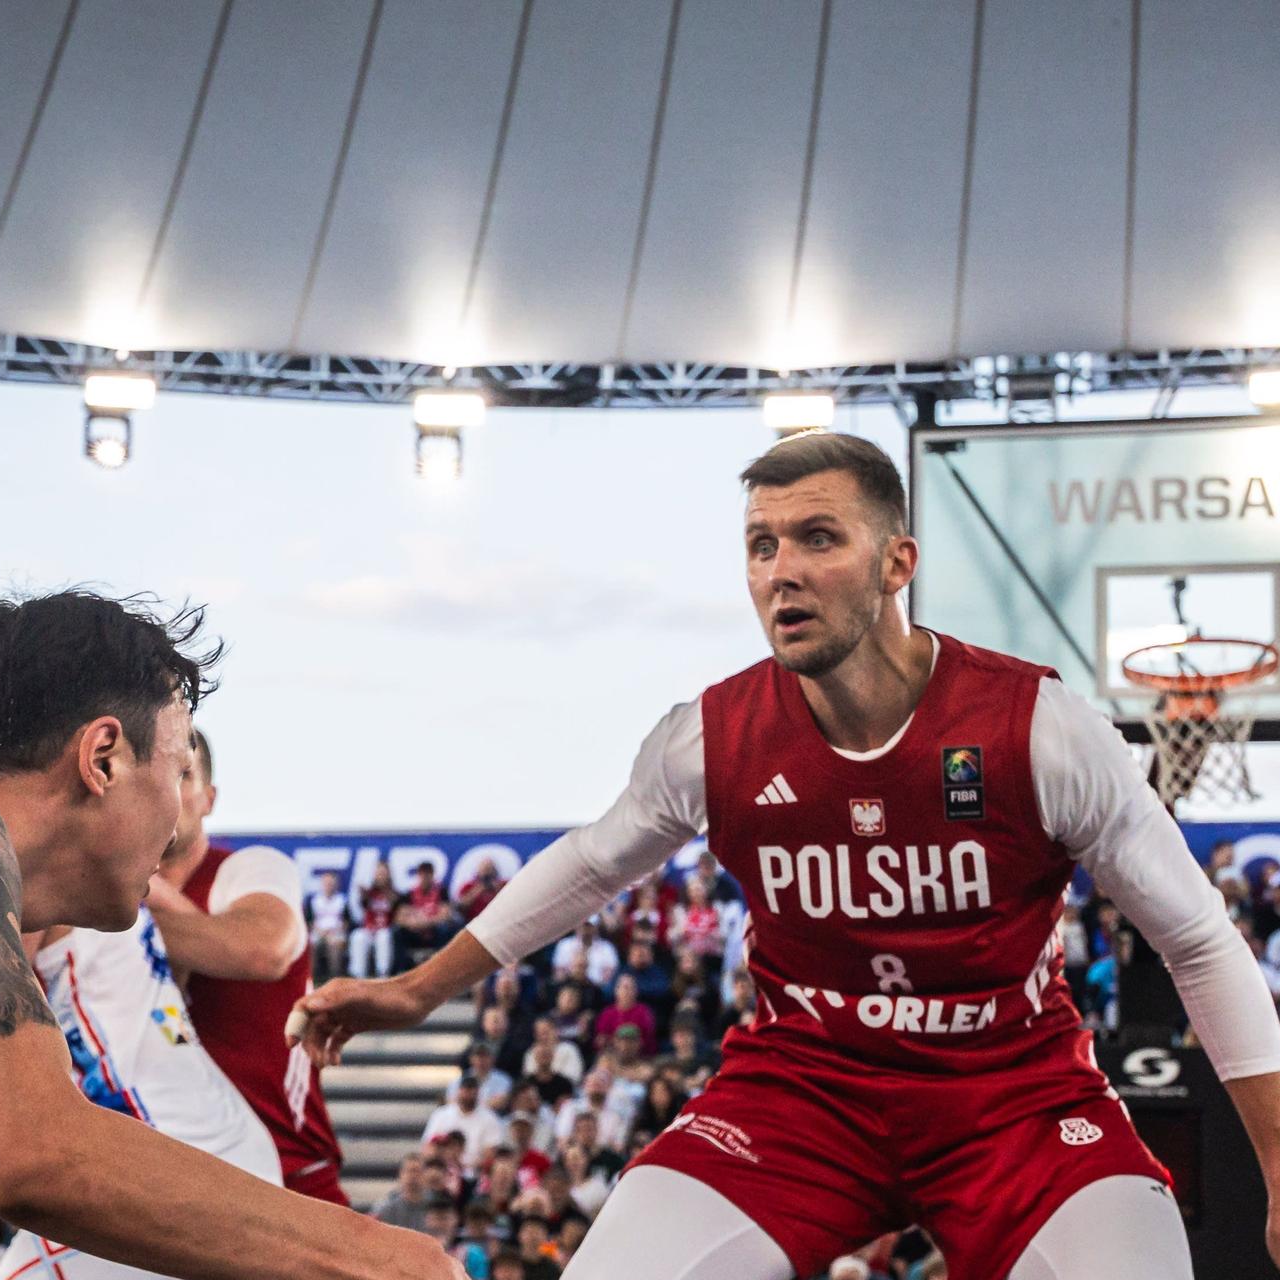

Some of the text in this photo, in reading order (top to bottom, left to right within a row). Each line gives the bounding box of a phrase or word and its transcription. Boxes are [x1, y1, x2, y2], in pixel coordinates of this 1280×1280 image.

[950, 789, 978, 803] FIBA
[757, 840, 991, 919] POLSKA
[870, 953, 913, 994] 8
[856, 994, 997, 1034] ORLEN
